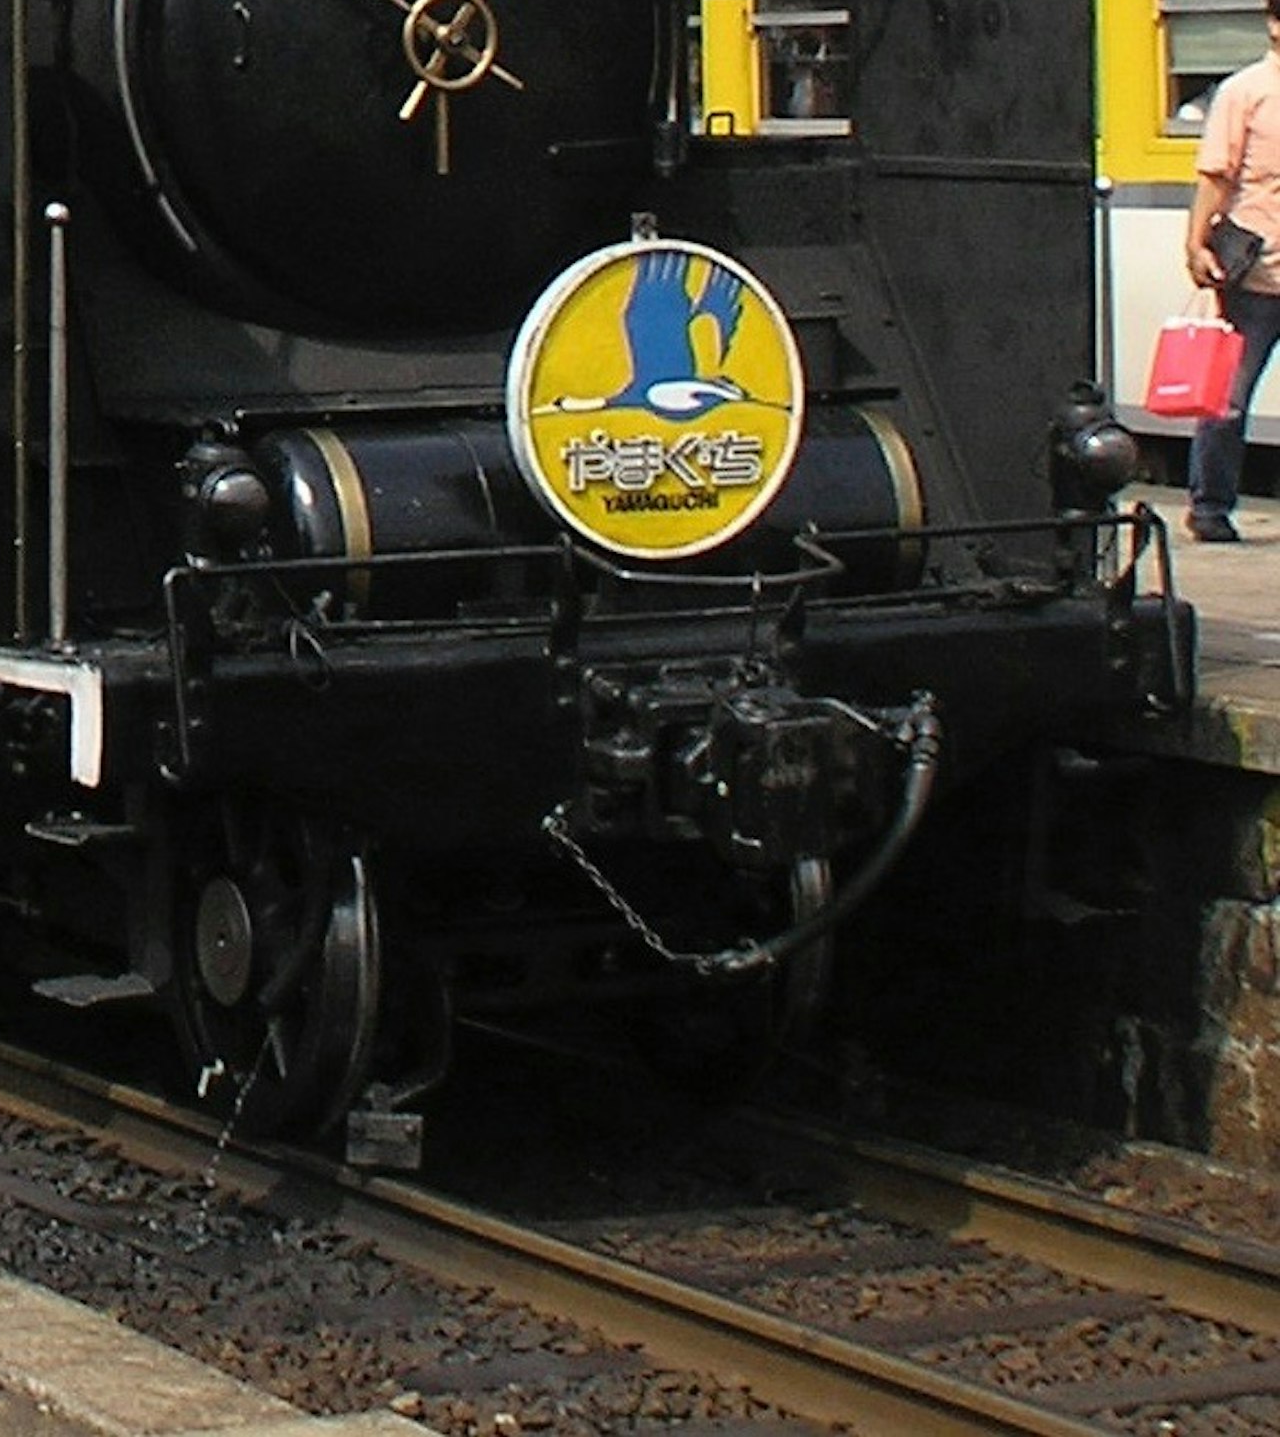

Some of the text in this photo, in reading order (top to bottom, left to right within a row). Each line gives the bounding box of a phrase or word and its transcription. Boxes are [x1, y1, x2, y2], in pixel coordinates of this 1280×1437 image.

[560, 427, 763, 494] やまぐち
[602, 491, 720, 514] YAMAGUCHI
